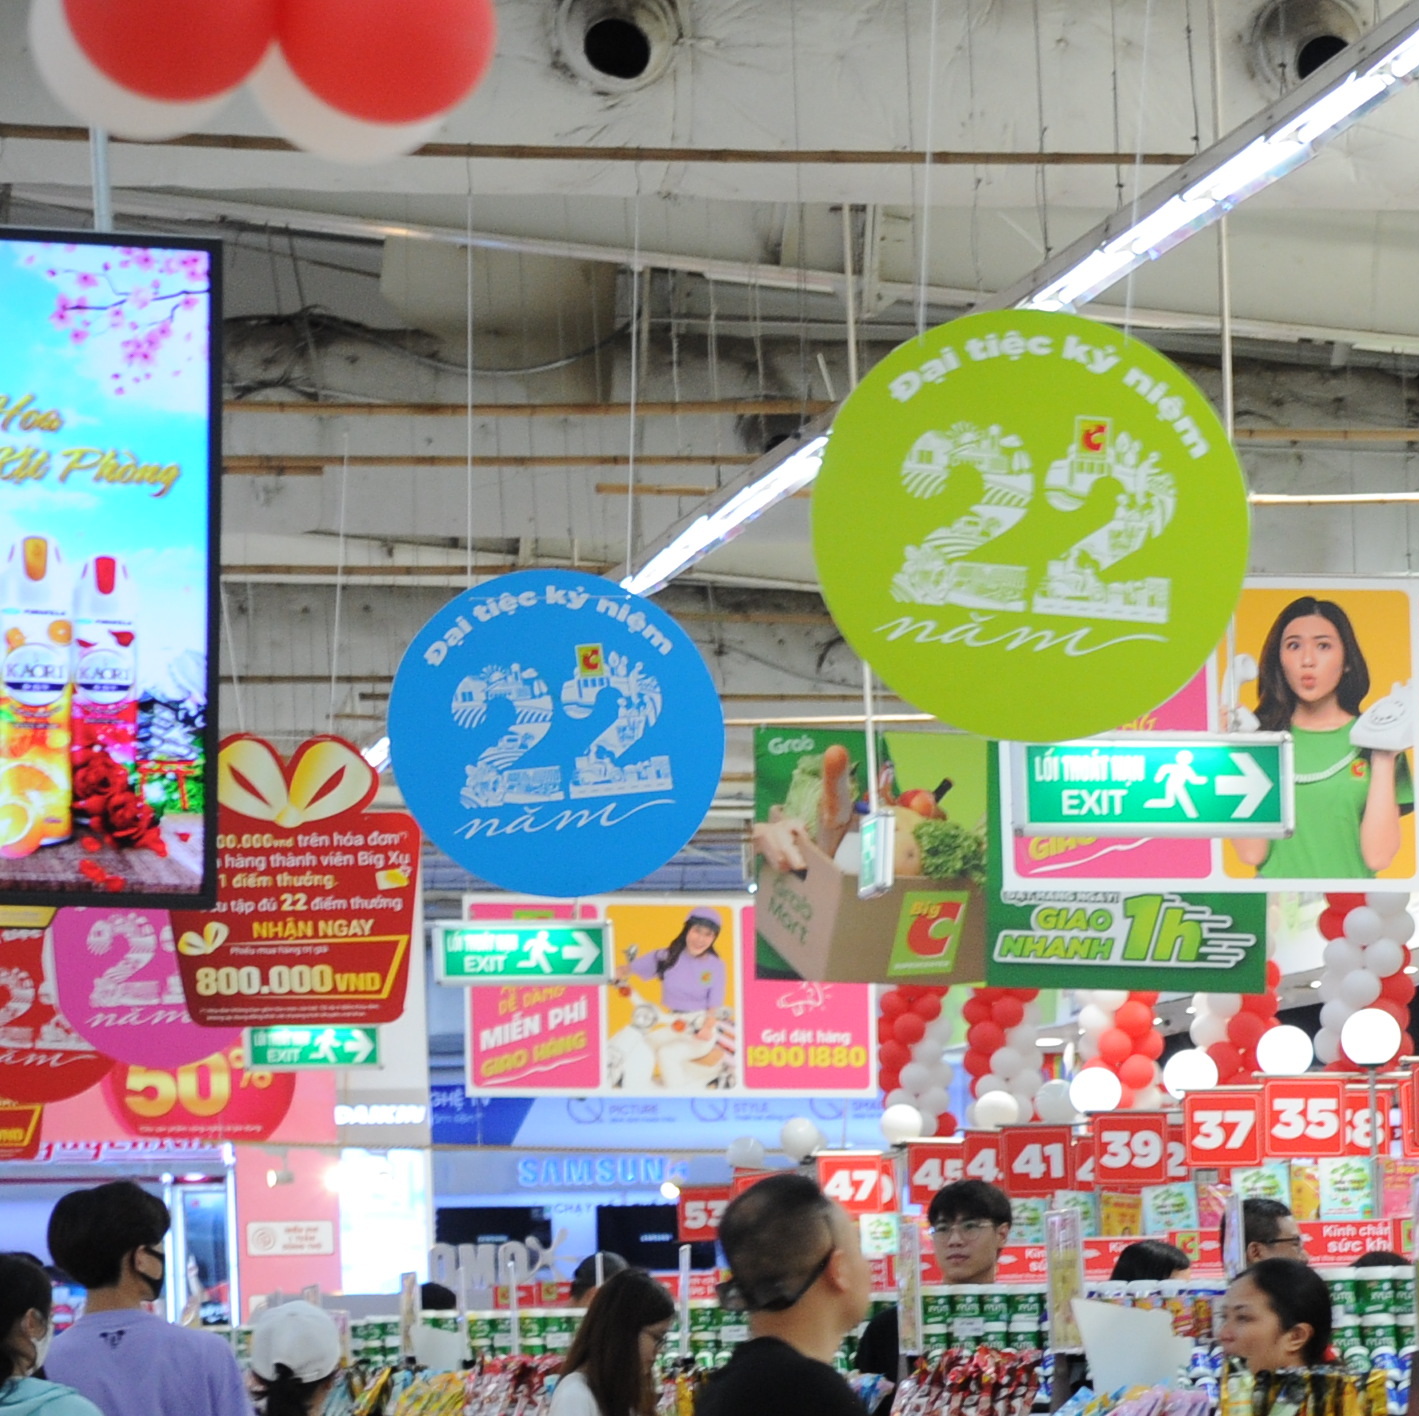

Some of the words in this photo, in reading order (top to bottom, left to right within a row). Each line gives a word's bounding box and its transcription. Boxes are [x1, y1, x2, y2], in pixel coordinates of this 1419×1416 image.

[888, 347, 960, 403] Đại
[964, 330, 1054, 362] tiệc
[1062, 335, 1120, 374] kỷ
[1122, 366, 1211, 459] niệm
[59, 449, 180, 497] Phòng
[890, 421, 1178, 624] 22
[423, 616, 473, 667] Đại
[473, 590, 538, 622] tiệc
[546, 585, 590, 609] kỷ
[596, 598, 674, 656] niệm
[874, 611, 1170, 657] năm
[6, 664, 66, 681] KAORI
[79, 665, 132, 681] KAORI
[452, 651, 673, 809] 22
[768, 735, 815, 755] Grab
[1034, 748, 1059, 782] LỐI
[1061, 789, 1128, 816] EXIT
[454, 799, 676, 839] năm
[298, 833, 329, 847] trên
[333, 831, 364, 847] hóa
[225, 853, 267, 871] hàng
[270, 852, 317, 867] thành
[320, 852, 354, 866] viên
[357, 851, 384, 868] Big
[232, 872, 272, 888] điểm
[230, 898, 254, 914] tập
[257, 897, 277, 912] đủ
[280, 893, 308, 911] 22
[310, 895, 346, 910] điểm
[350, 896, 403, 912] thưởng
[910, 901, 942, 919] Big
[252, 917, 314, 940] NHẬN
[318, 919, 375, 936] NGAY
[907, 901, 964, 959] C
[1036, 907, 1113, 931] GIAO
[1122, 894, 1203, 962] 1h
[1000, 935, 1114, 960] NHANH
[463, 955, 507, 973] EXIT
[481, 1012, 542, 1052] MIỄN
[548, 995, 587, 1030] PHÍ
[761, 1029, 785, 1046] Gọi
[789, 1030, 812, 1045] đặt
[816, 1030, 851, 1046] hàng
[266, 1047, 300, 1064] EXIT
[481, 1049, 529, 1077] GIAO
[747, 1046, 805, 1067] 1900
[808, 1046, 866, 1068] 1880
[334, 1104, 426, 1125] DAIKIN
[1271, 1097, 1339, 1140] 35
[1191, 1110, 1255, 1150] 37
[1011, 1142, 1063, 1180] 41
[1100, 1129, 1162, 1169] 39
[823, 1170, 878, 1201] 47
[431, 1242, 537, 1285] OMO
